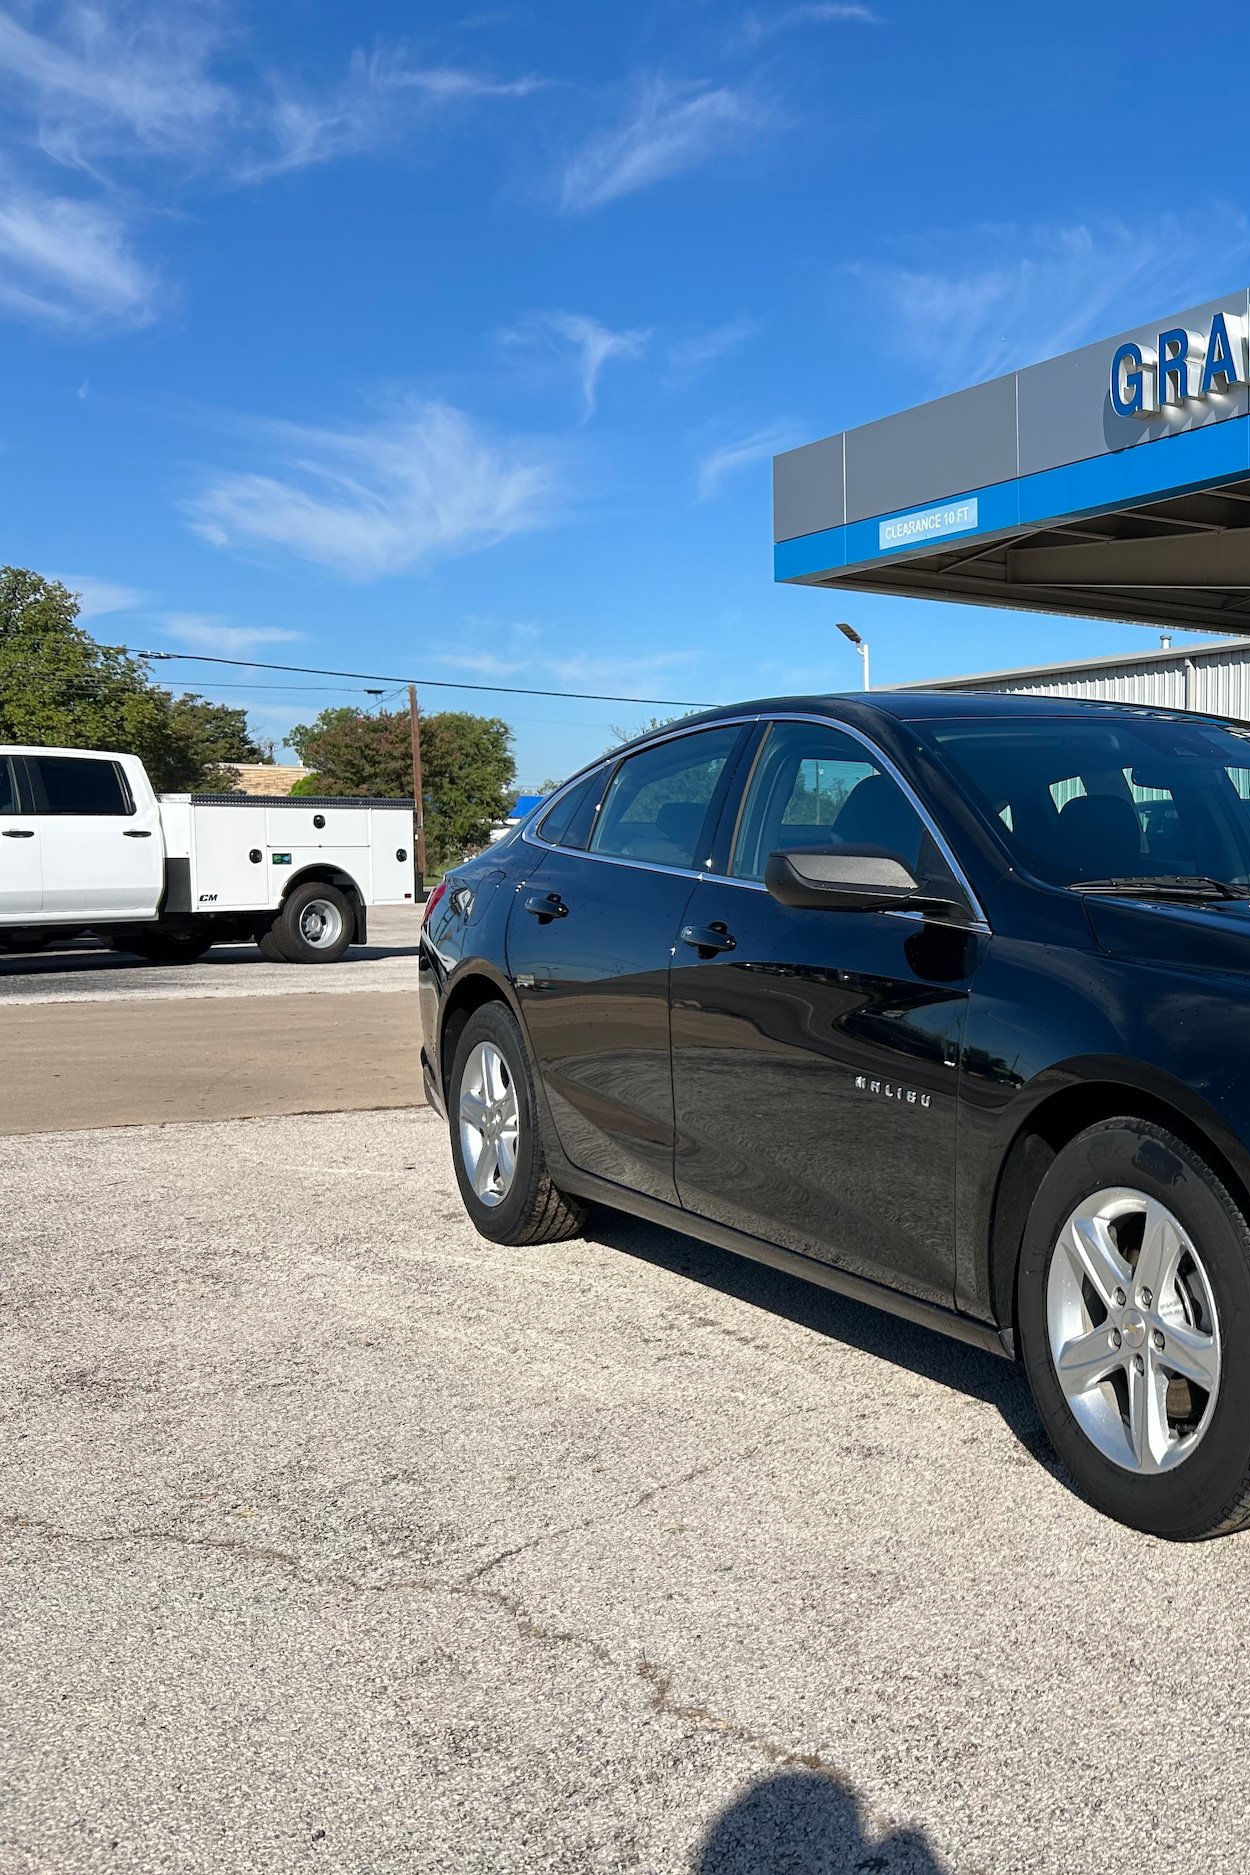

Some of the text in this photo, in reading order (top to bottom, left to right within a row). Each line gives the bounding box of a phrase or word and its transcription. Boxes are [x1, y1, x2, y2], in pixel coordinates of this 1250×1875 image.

[885, 507, 969, 540] CLEARANCE 10 FT
[199, 894, 218, 902] CM
[855, 1075, 931, 1108] MALIBU
